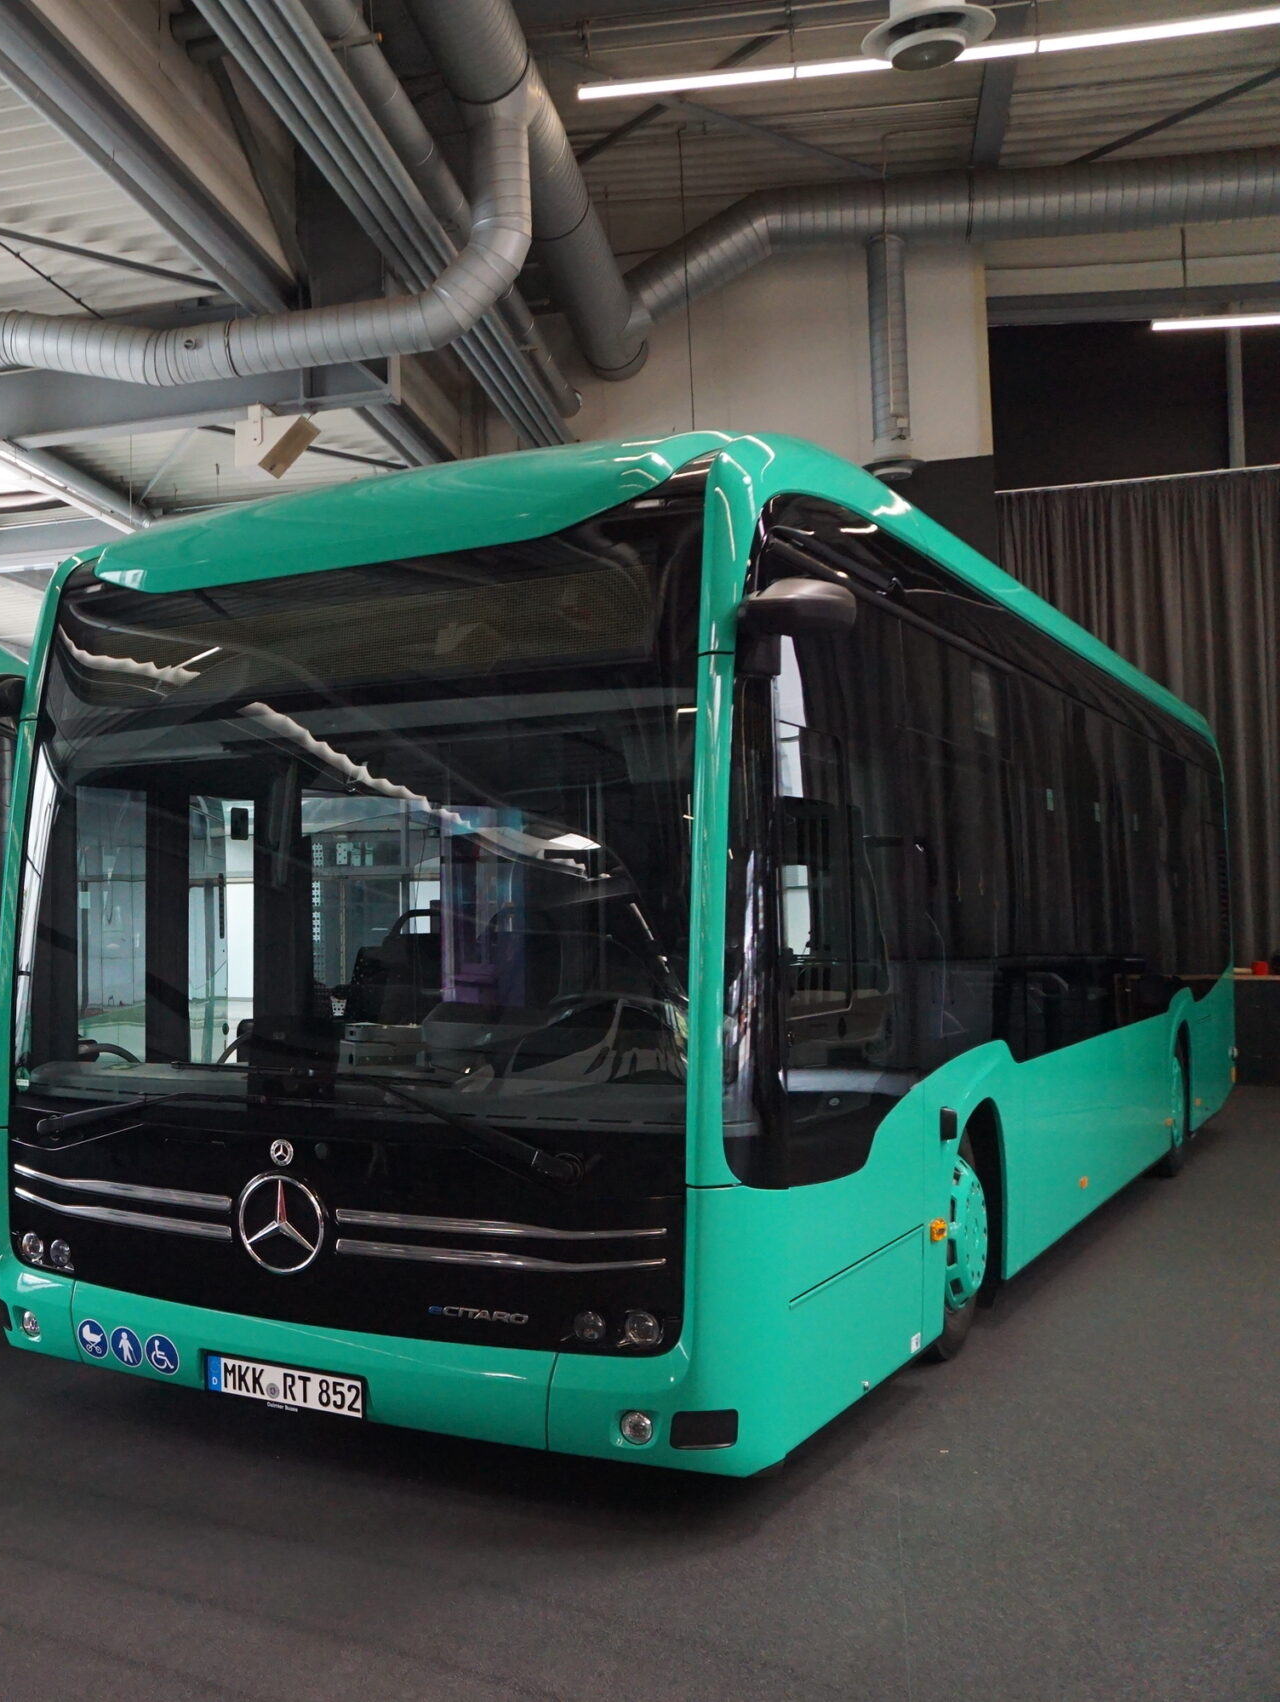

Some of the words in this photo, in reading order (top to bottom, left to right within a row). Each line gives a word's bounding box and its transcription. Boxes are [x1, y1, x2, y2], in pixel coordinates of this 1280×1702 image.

[427, 1305, 529, 1324] eCITARO
[212, 1376, 218, 1385] D
[223, 1362, 265, 1396] MKK
[283, 1372, 311, 1403] RT
[318, 1379, 361, 1413] 852
